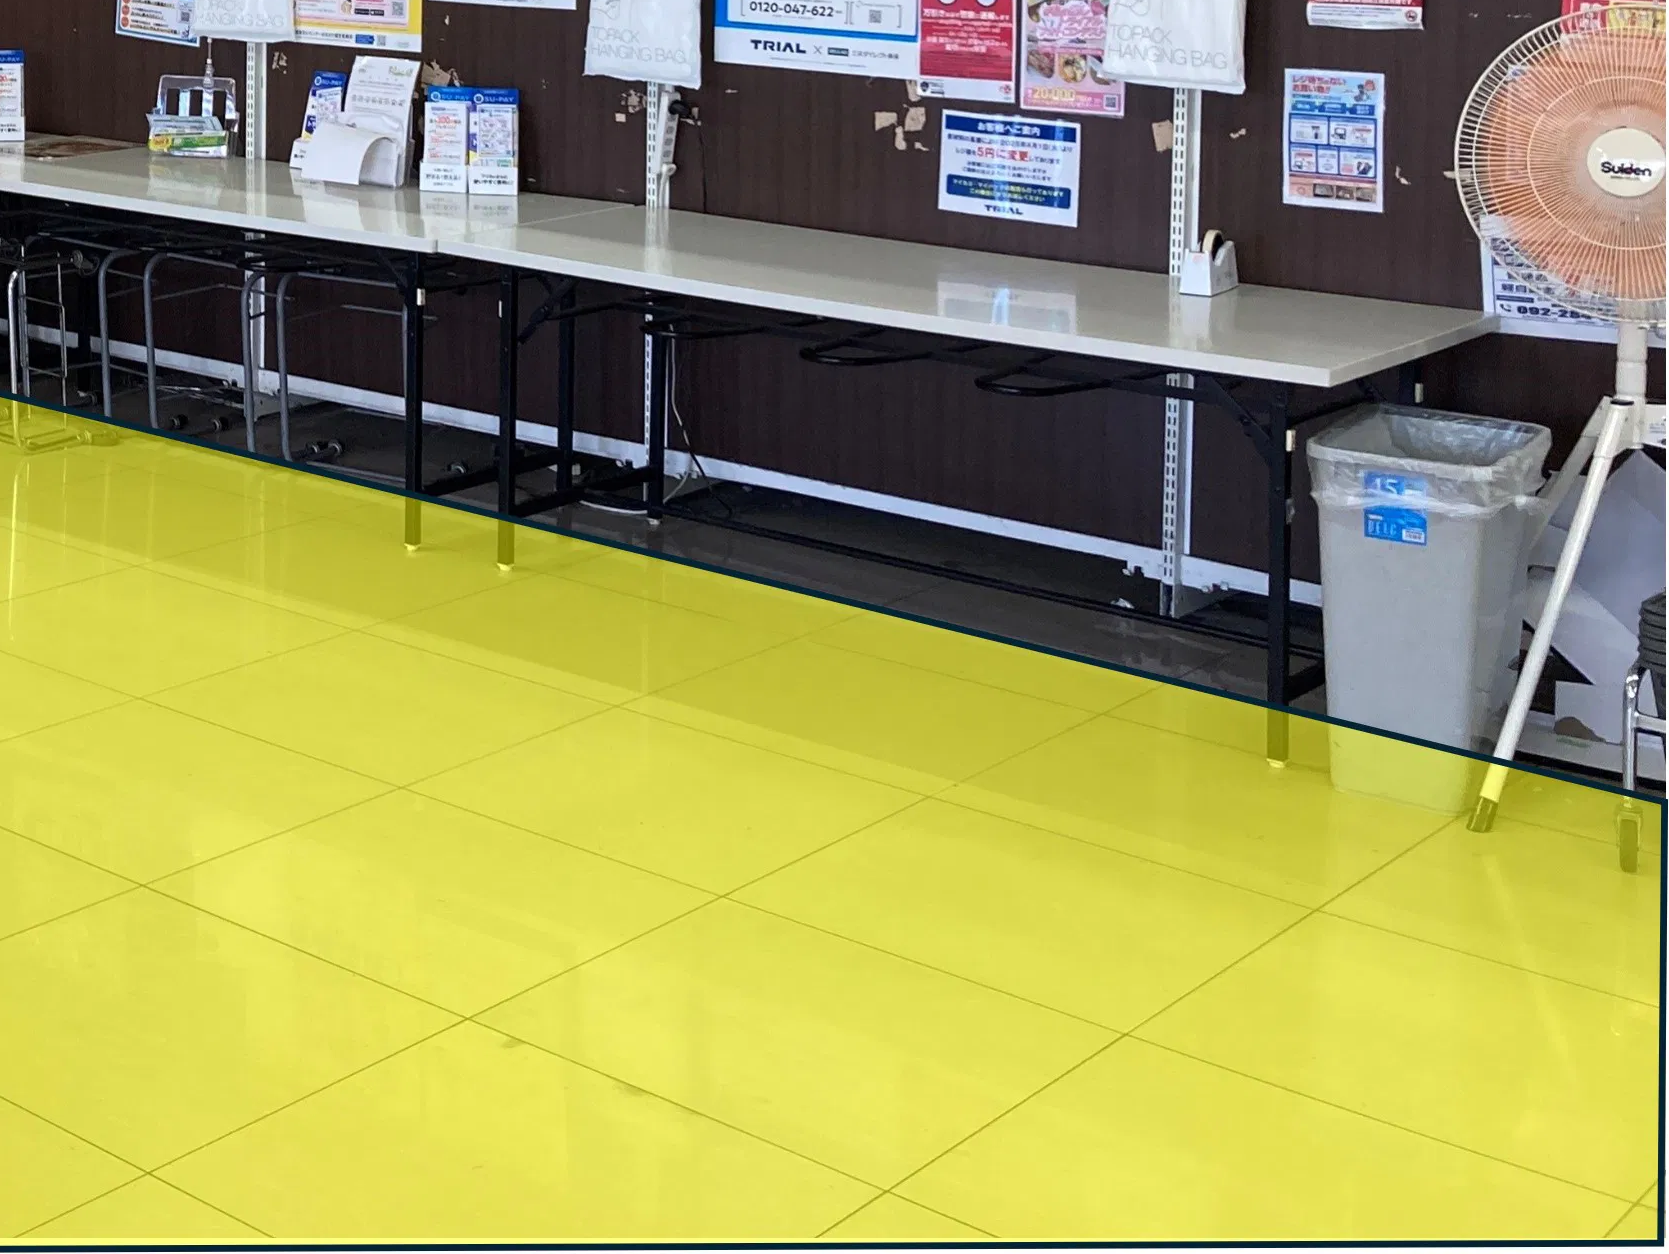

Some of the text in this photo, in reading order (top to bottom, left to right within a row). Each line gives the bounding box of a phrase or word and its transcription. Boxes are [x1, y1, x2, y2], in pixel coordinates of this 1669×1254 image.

[749, 1, 834, 17] 0120-047-622
[750, 39, 807, 54] TRIAL
[1192, 52, 1228, 69] BAG
[1601, 161, 1652, 177] Suiden
